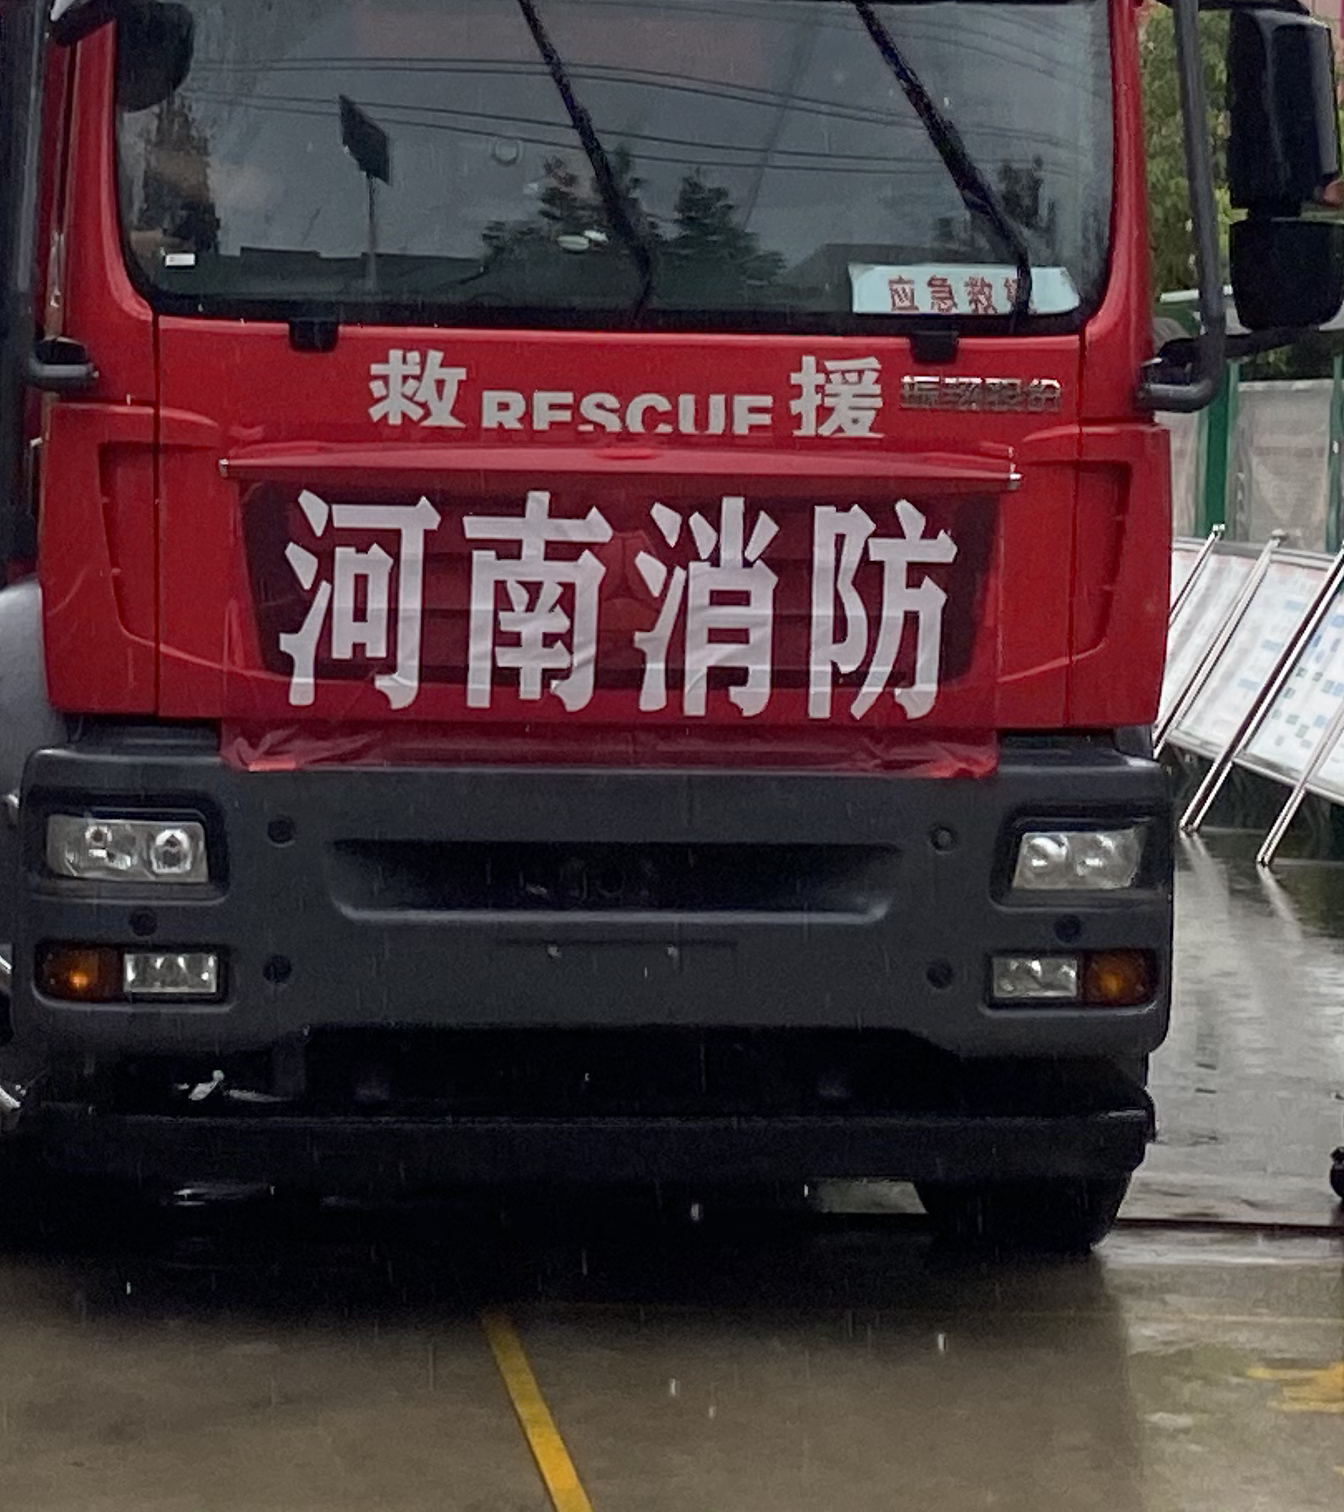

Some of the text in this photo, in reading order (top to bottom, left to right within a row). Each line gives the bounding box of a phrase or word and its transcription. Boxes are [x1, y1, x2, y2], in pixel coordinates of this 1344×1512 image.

[369, 349, 885, 438] 救 RESCUE 援
[279, 489, 958, 721] 河南消防
